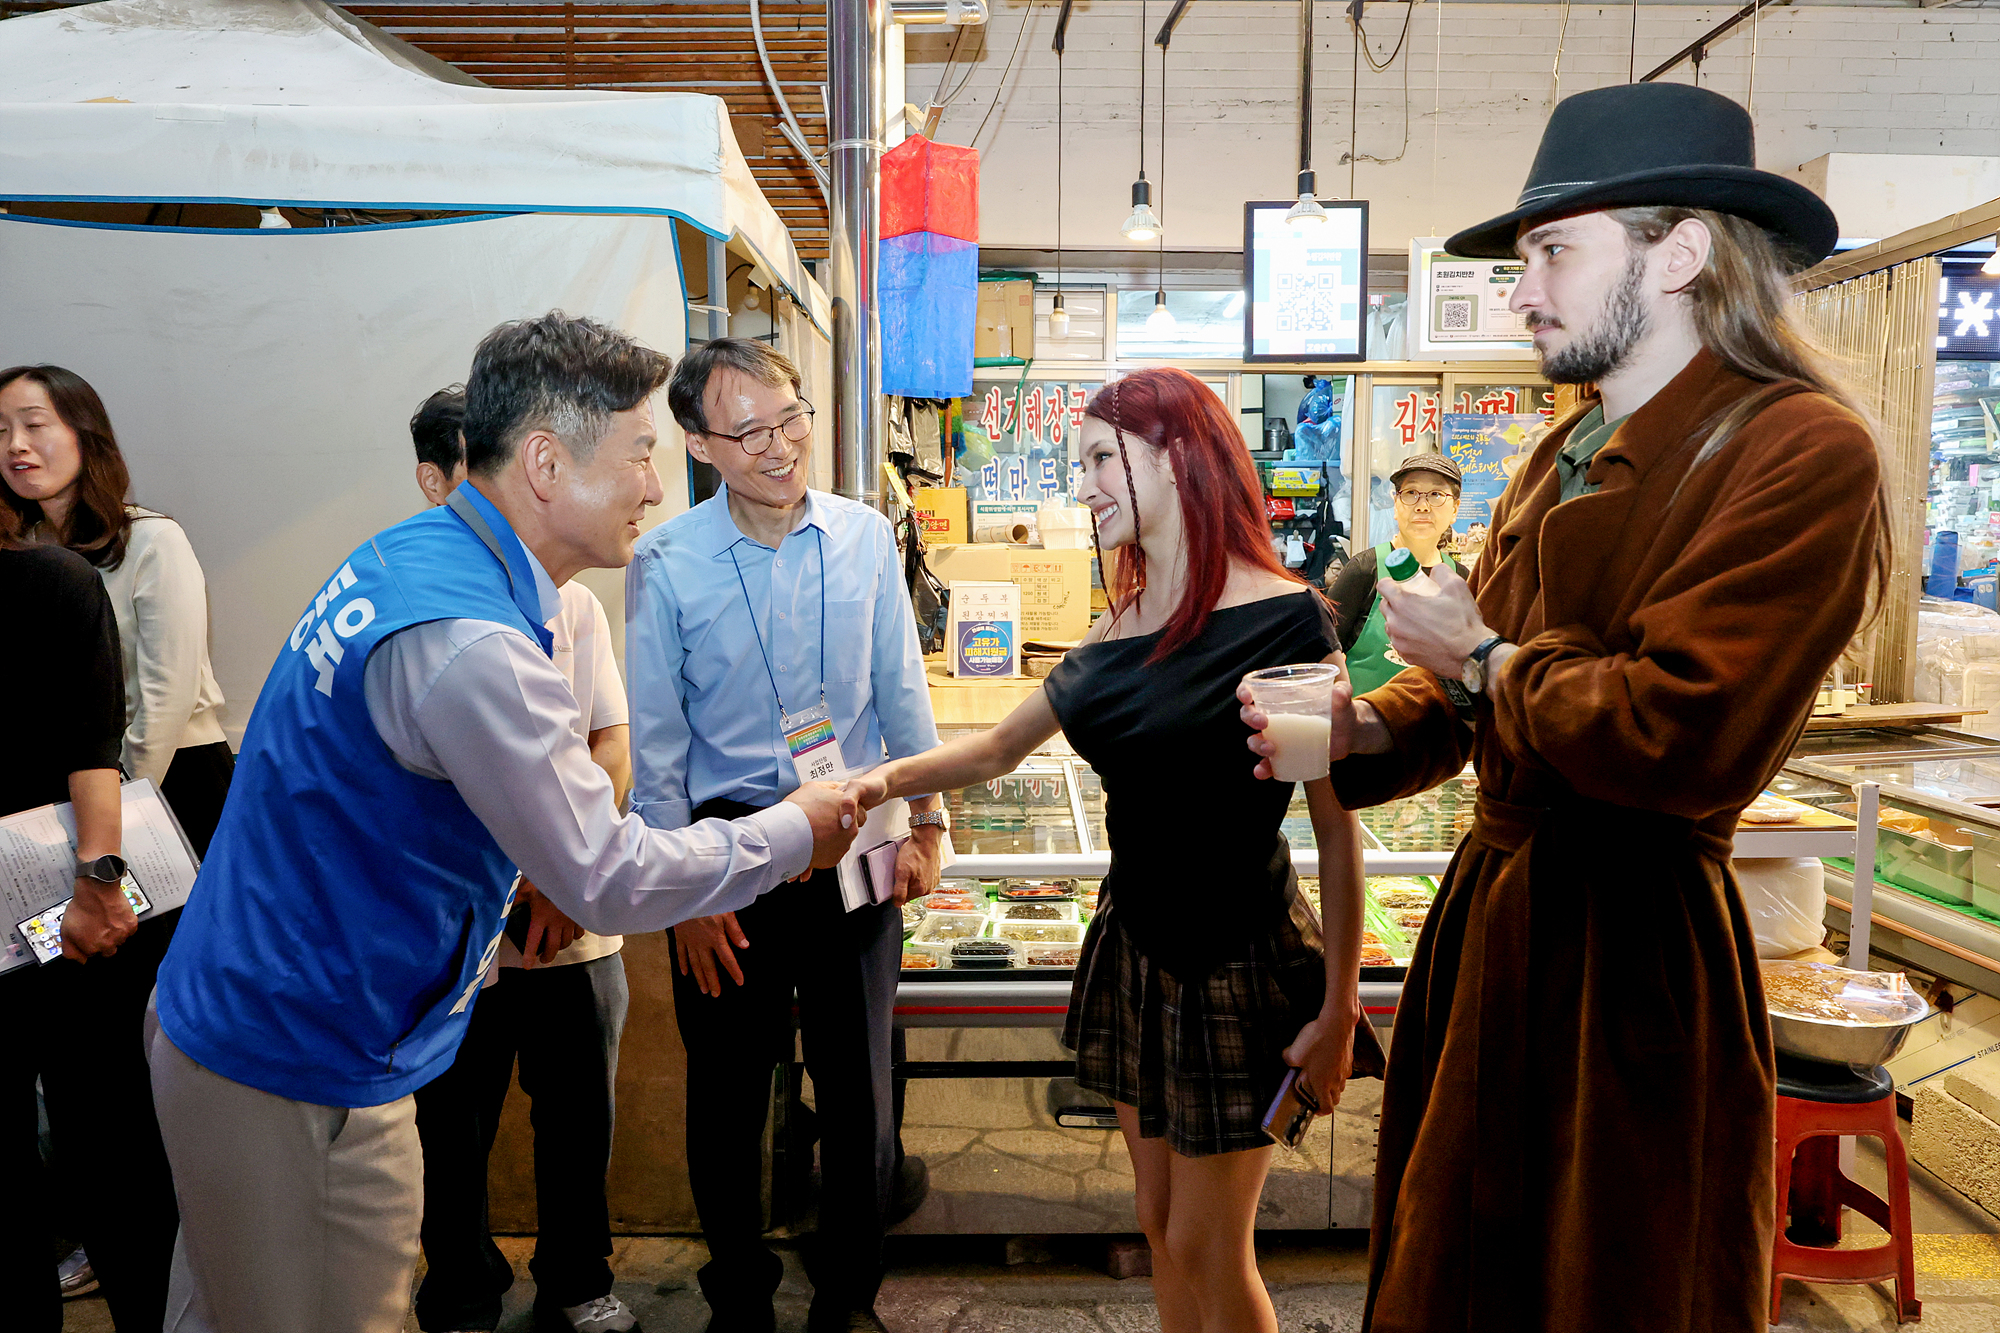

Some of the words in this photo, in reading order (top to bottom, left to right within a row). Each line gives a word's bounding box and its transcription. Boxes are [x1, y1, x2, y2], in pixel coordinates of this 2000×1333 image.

[1450, 441, 1483, 465] 막걸리
[1459, 461, 1510, 480] 페스티벌
[972, 637, 1000, 647] 고유가
[964, 647, 1008, 657] 피해지원금
[809, 762, 834, 780] 최정만
